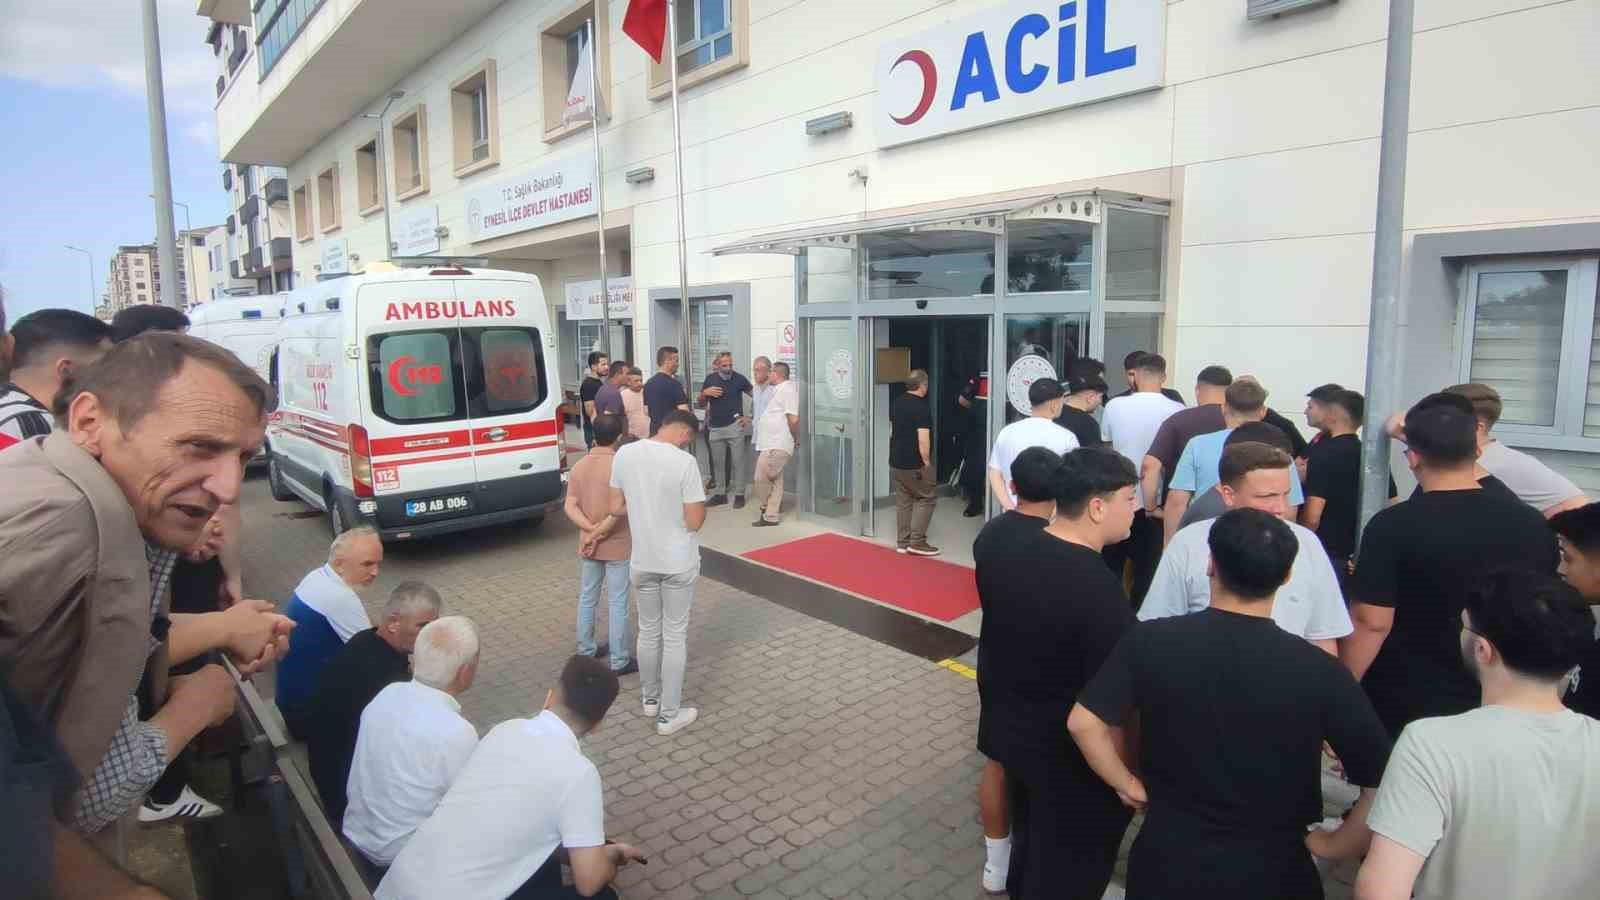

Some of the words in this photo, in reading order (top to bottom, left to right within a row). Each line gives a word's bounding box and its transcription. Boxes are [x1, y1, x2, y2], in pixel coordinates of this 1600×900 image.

[522, 198, 548, 219] DEVLET
[549, 182, 593, 212] HASTANESİ
[385, 299, 516, 321] AMBULANS
[376, 469, 396, 482] 112
[413, 501, 427, 514] 28
[429, 499, 444, 512] AB
[447, 496, 468, 509] 006
